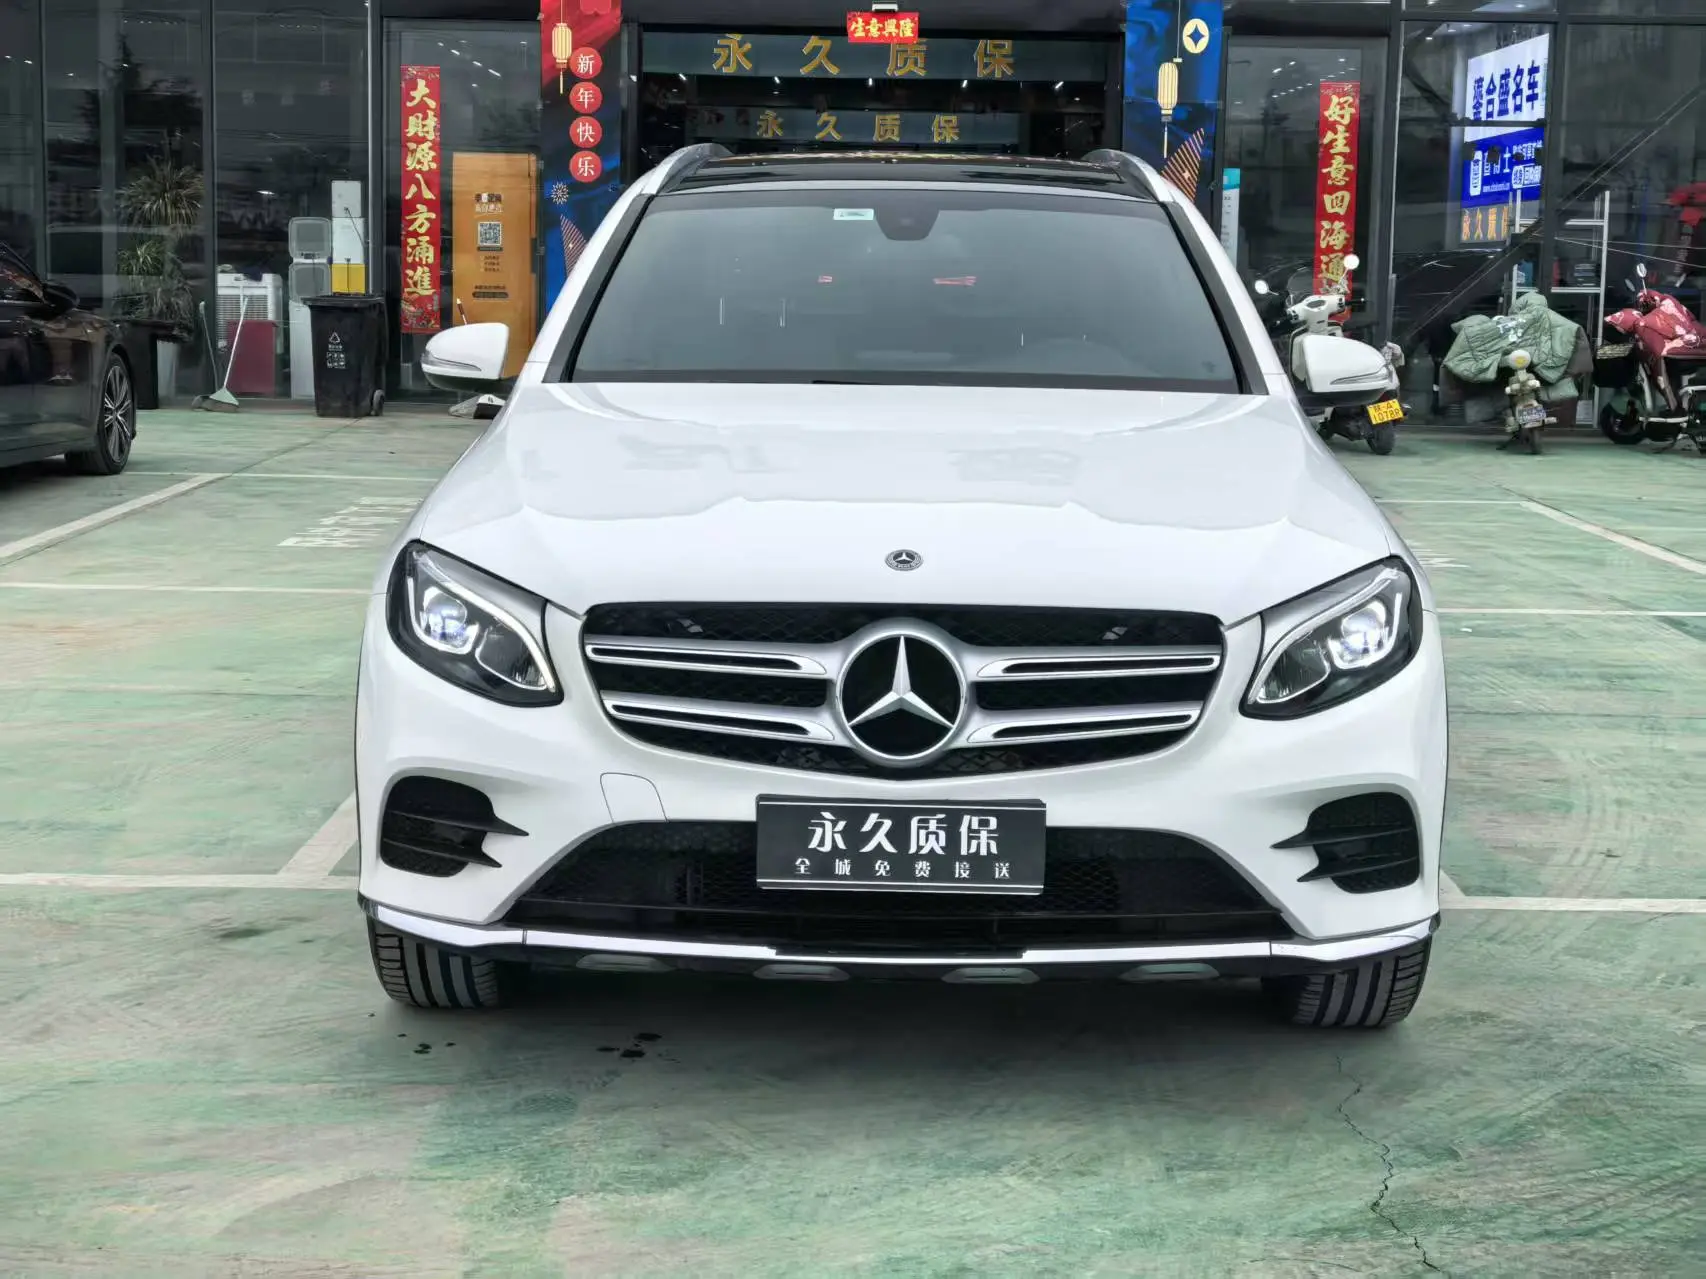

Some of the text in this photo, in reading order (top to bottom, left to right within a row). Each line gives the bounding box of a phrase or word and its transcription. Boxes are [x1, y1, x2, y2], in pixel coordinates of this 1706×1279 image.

[850, 17, 915, 38] 生意興隆
[713, 34, 1016, 78] 永久质保
[576, 54, 595, 177] 新年快乐
[756, 110, 961, 143] 永久质保
[1319, 95, 1356, 294] 好生意四海通
[808, 811, 998, 856] 永久质保
[795, 858, 1011, 880] 全城免费接送
